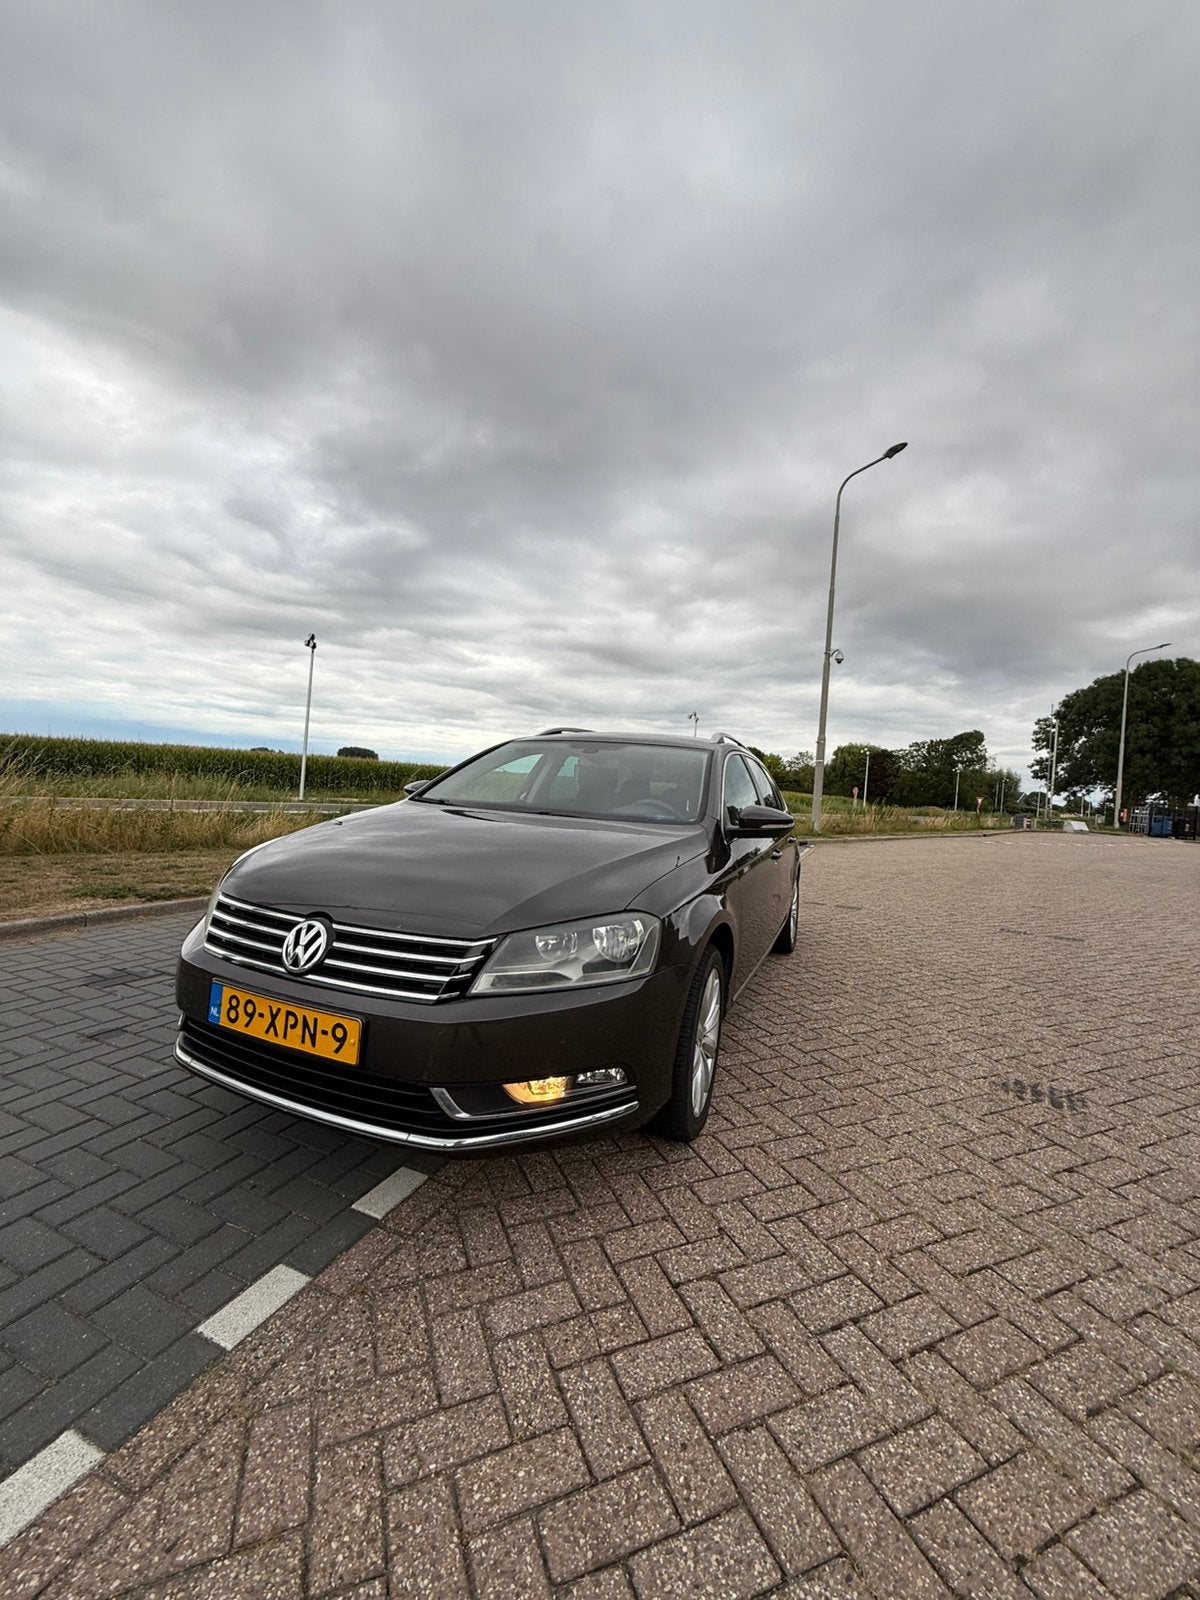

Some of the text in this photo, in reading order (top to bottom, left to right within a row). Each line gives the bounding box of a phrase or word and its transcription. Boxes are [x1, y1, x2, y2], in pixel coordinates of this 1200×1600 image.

[283, 920, 327, 970] VW
[210, 1006, 219, 1017] NL
[226, 994, 348, 1054] 89-XPN-9
